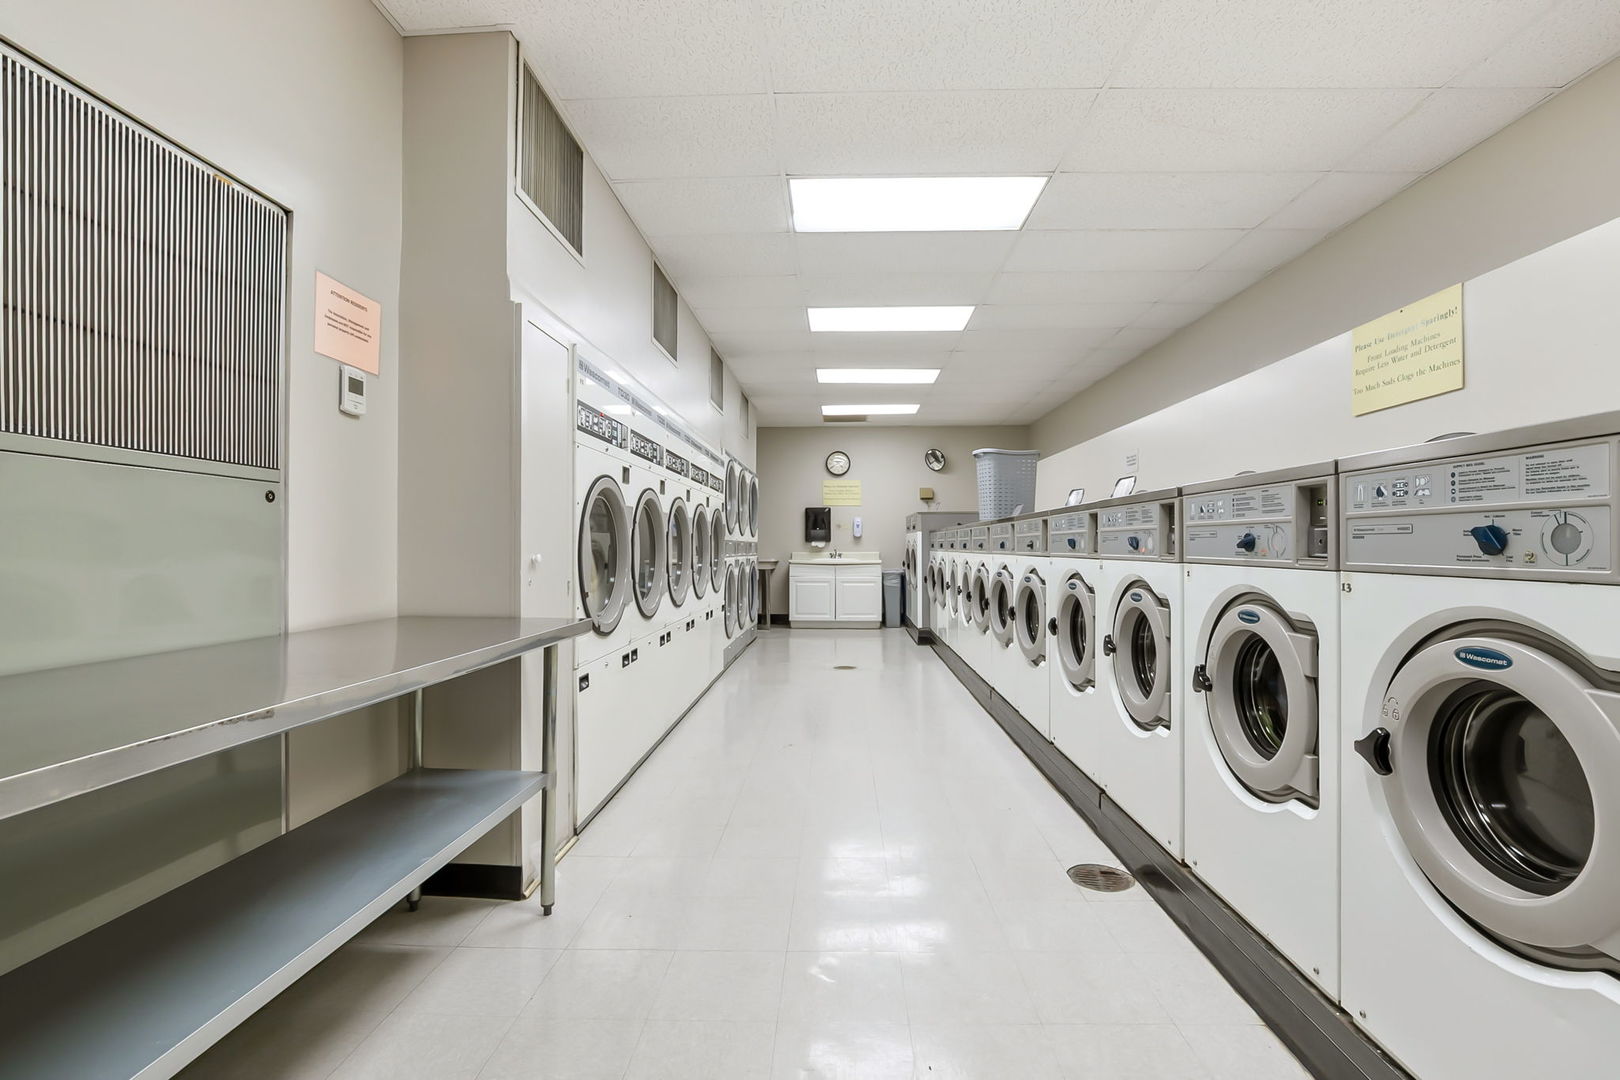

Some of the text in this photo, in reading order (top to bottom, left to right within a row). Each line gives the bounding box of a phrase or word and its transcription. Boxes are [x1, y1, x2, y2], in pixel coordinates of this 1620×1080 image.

[1354, 342, 1372, 353] Please
[1374, 337, 1385, 345] Use
[1420, 306, 1458, 328] Sparingly!
[1355, 337, 1457, 377] Require Less Water and Detergent
[1367, 332, 1441, 363] Front Loading Machines
[1353, 387, 1364, 396] Too
[1397, 372, 1414, 383] Clogs
[1416, 368, 1426, 377] the
[1428, 359, 1461, 373] Machines
[1341, 582, 1352, 593] 13
[1465, 653, 1508, 666] Wascomat
